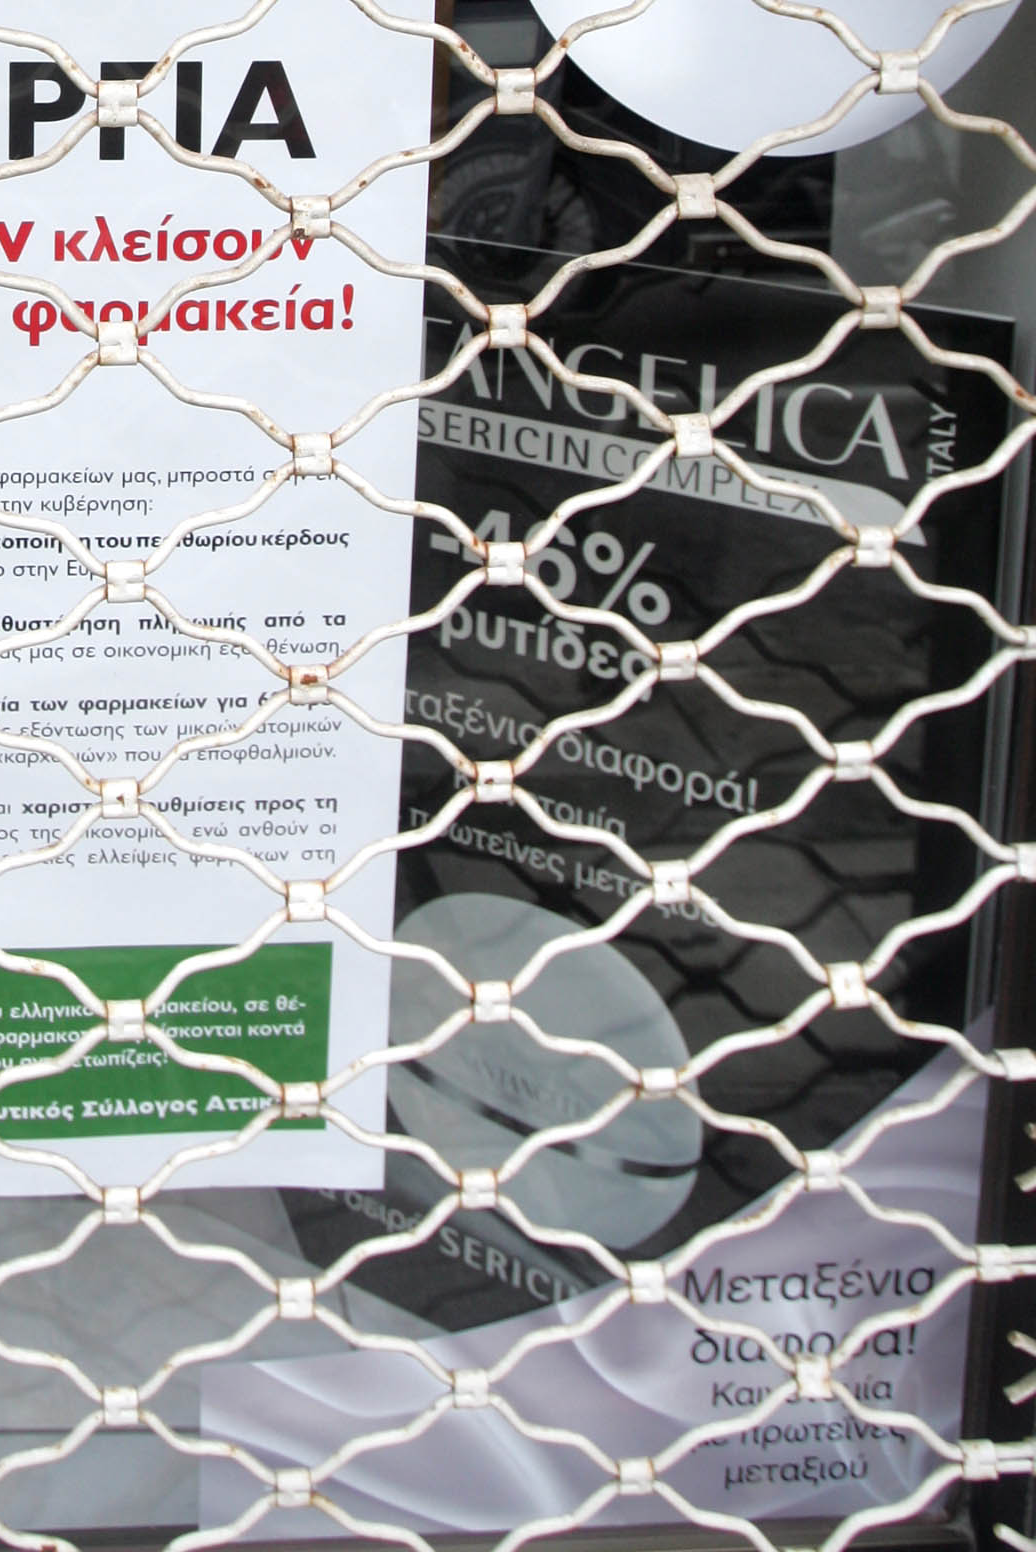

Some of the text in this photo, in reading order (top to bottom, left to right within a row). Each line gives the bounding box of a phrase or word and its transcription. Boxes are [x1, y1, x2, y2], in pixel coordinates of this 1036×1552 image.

[418, 405, 591, 470] SERICIN
[122, 469, 162, 488] μας,
[167, 466, 255, 487] μπροστά
[1, 500, 33, 517] την
[41, 494, 154, 516] κυβέρνηση:
[95, 535, 132, 549] του
[261, 529, 351, 550] κέρδους
[12, 563, 60, 581] στην
[264, 611, 306, 628] από
[322, 614, 347, 627] τα
[30, 647, 65, 664] μας
[72, 646, 96, 659] σε
[103, 641, 211, 662] οικονομική
[30, 700, 68, 712] των
[78, 693, 208, 715] φαρμακείων
[216, 696, 249, 713] για
[134, 724, 169, 736] των
[125, 751, 162, 763] που
[197, 743, 337, 764] εποφθαλμιούν.
[557, 726, 762, 815] διαφορά!
[254, 798, 306, 815] προς
[314, 797, 339, 813] τη
[30, 829, 61, 843] της
[192, 823, 229, 838] ενώ
[238, 820, 310, 838] ανθούν
[319, 823, 338, 836] οι
[87, 849, 177, 869] ελλείψεις
[301, 848, 336, 864] στη
[244, 1000, 270, 1012] σε
[275, 994, 306, 1012] θέ-
[248, 1020, 305, 1037] κοντά
[81, 1097, 199, 1119] Σύλλογος
[684, 1260, 936, 1310] Μεταξένια
[724, 1455, 869, 1490] μεταξιού
